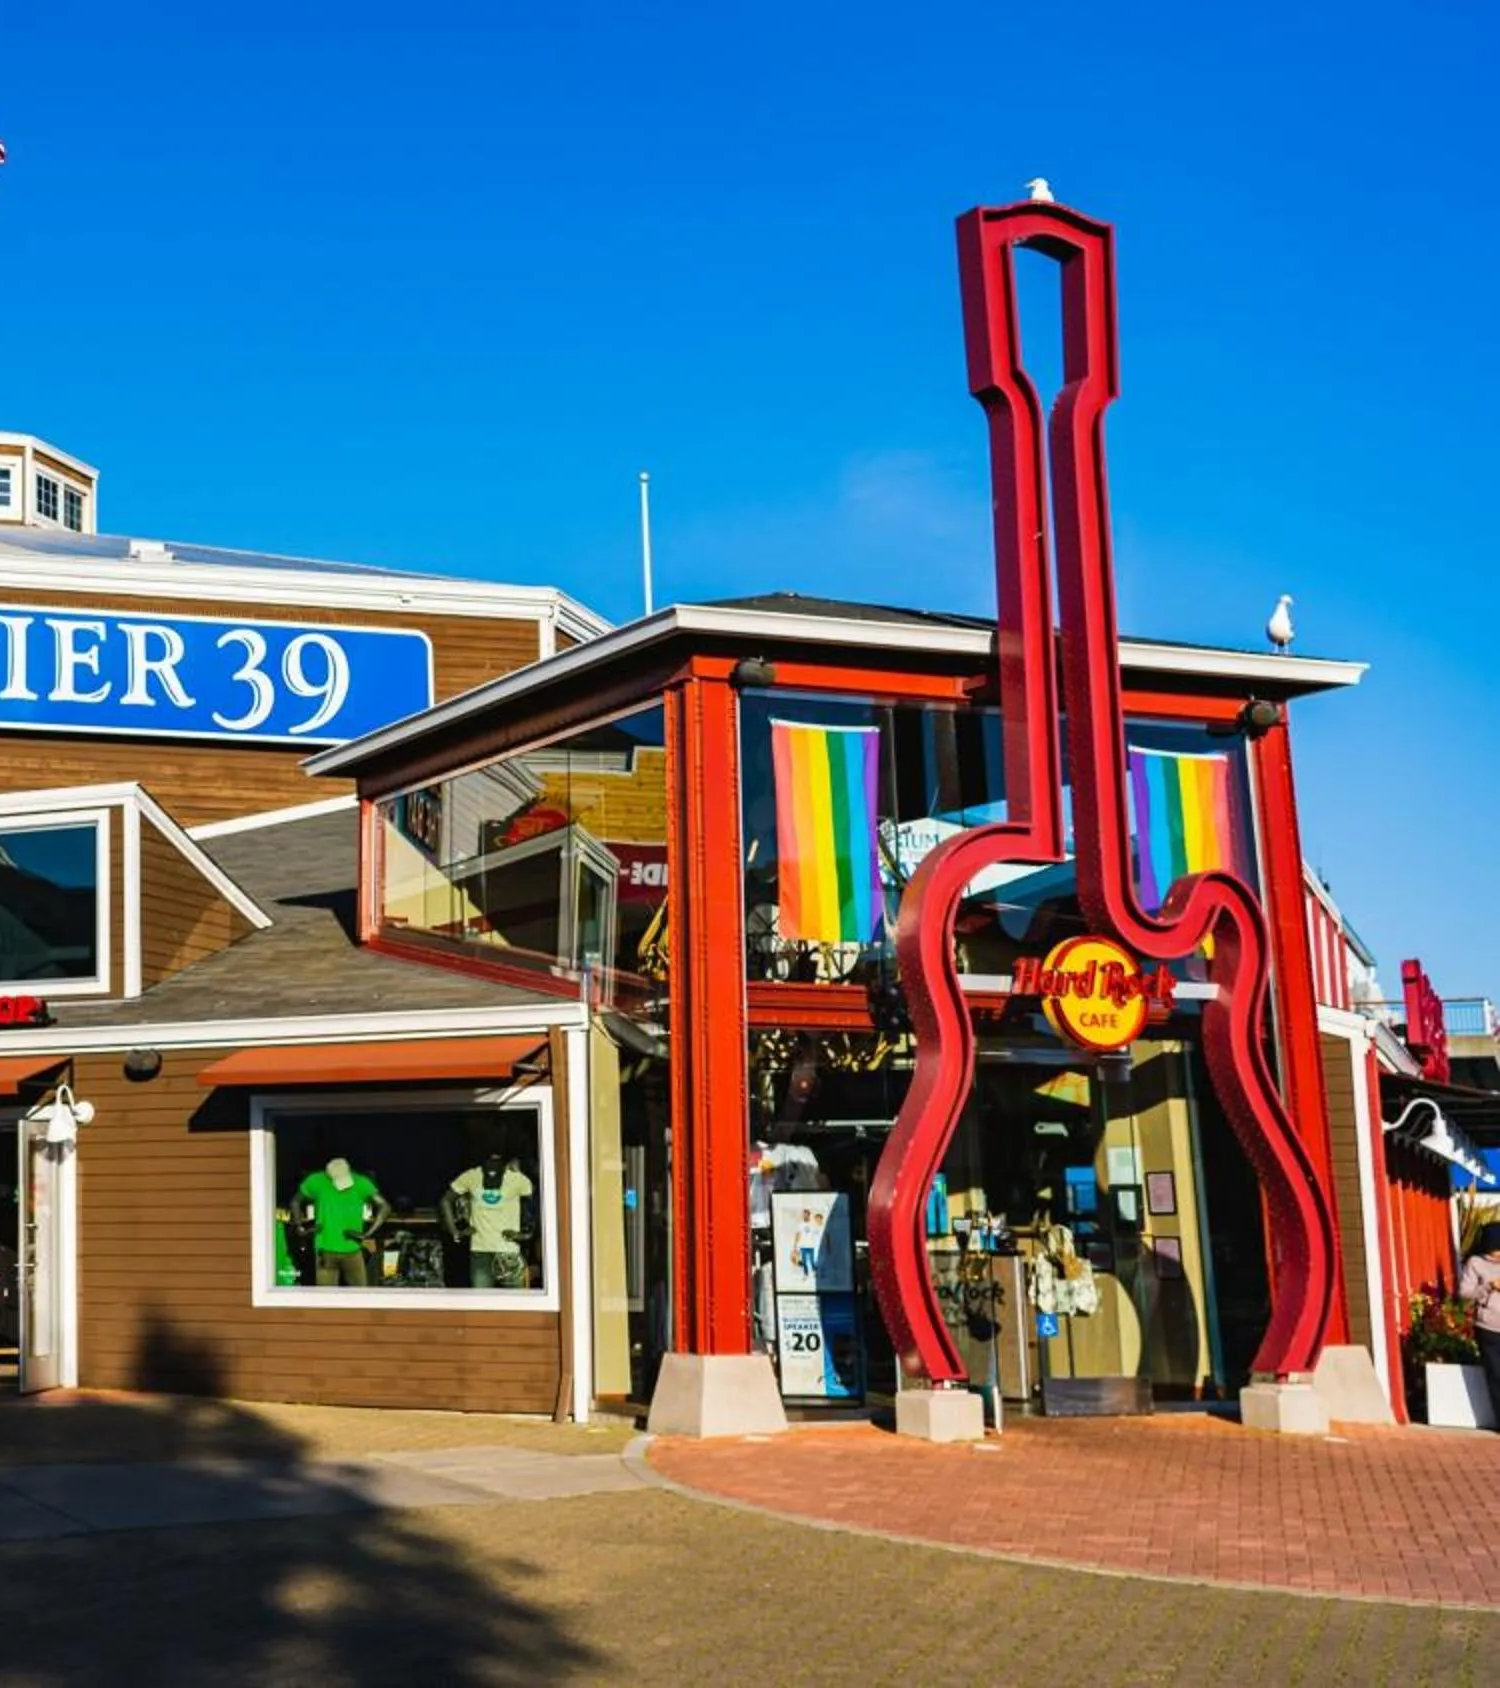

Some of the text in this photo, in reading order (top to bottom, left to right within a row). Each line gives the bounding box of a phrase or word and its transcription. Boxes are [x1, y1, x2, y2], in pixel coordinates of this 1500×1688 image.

[211, 628, 351, 736] 39
[1011, 956, 1178, 1011] Hard Rock
[1079, 1012, 1120, 1029] CAFE
